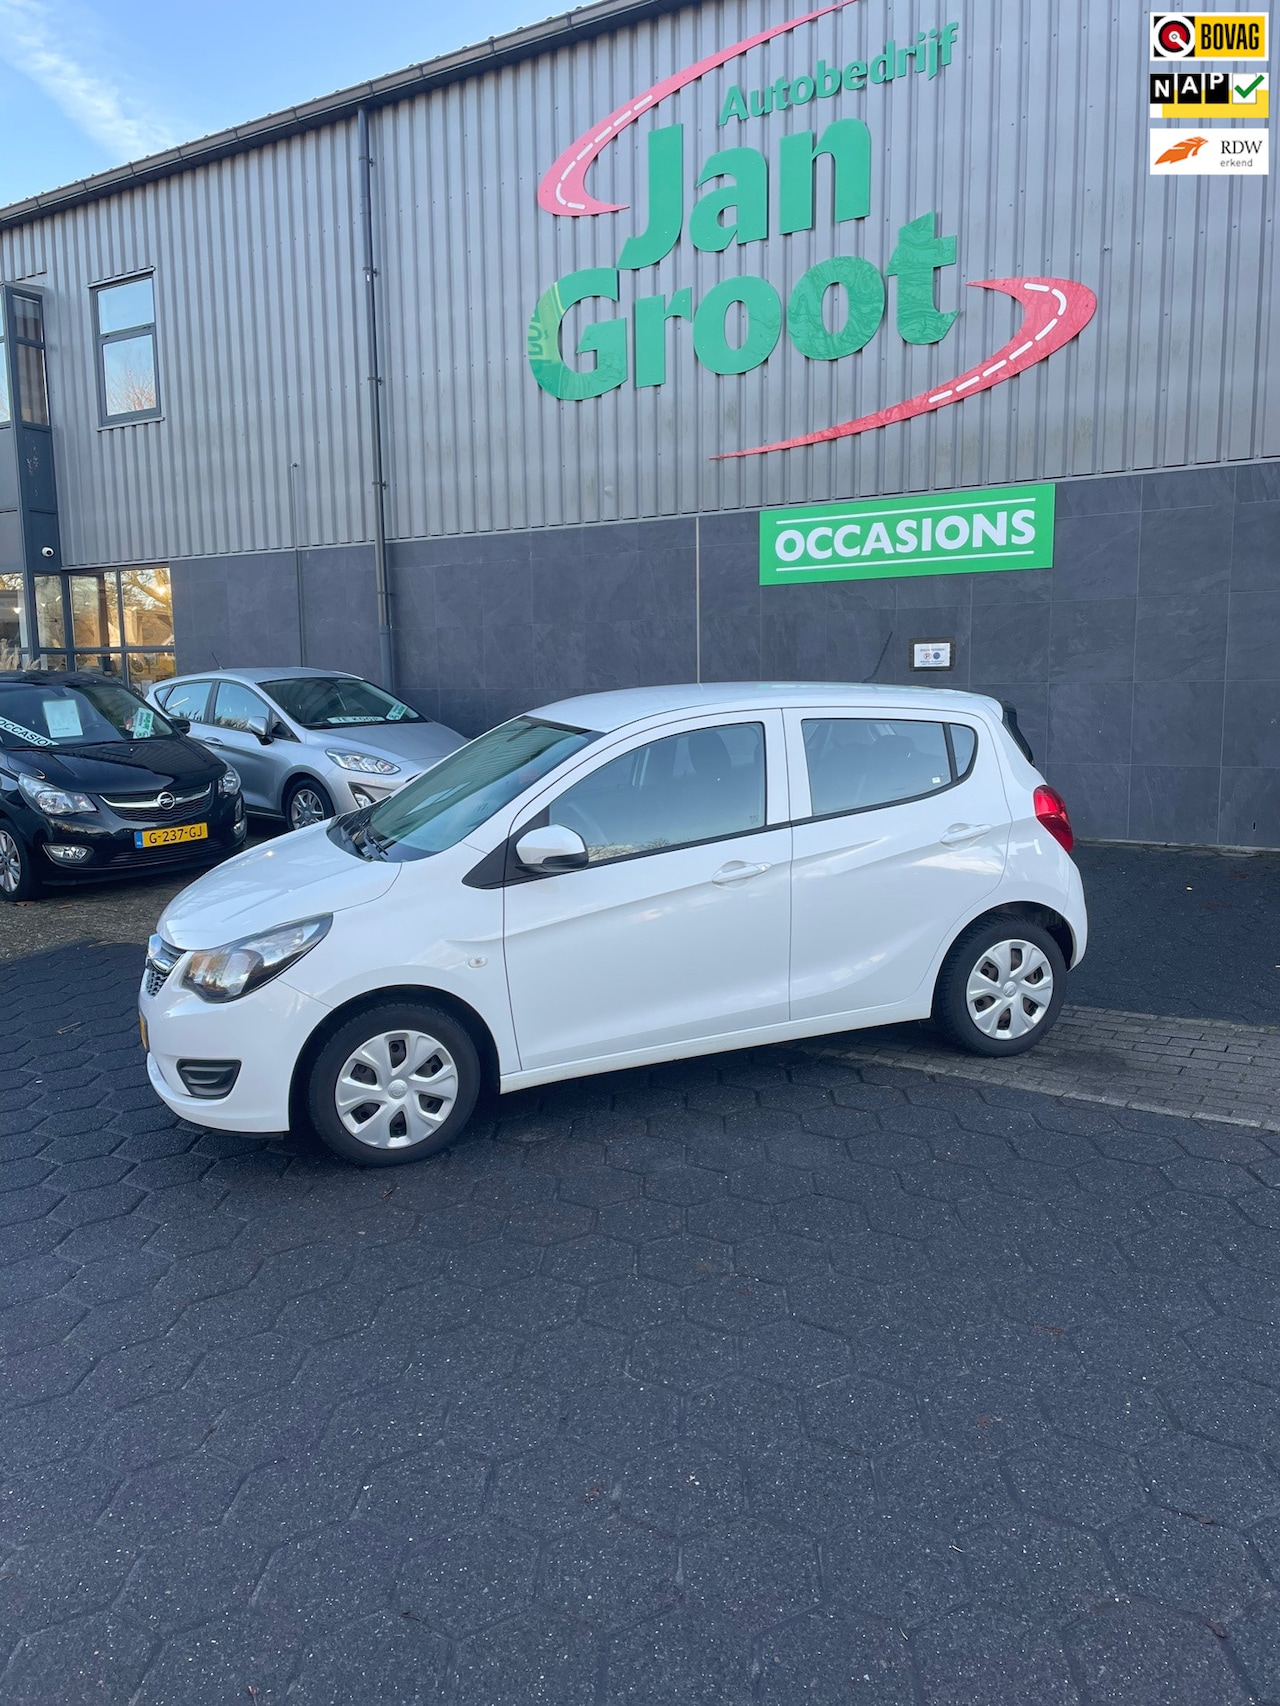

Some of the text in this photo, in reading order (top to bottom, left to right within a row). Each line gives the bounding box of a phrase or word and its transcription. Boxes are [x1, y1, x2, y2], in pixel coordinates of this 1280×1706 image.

[718, 22, 959, 126] Autobedrijf
[617, 117, 872, 270] Jan
[526, 210, 962, 402] Groot
[774, 508, 1036, 562] OCCASIONS
[149, 825, 203, 844] G-237-GJ
